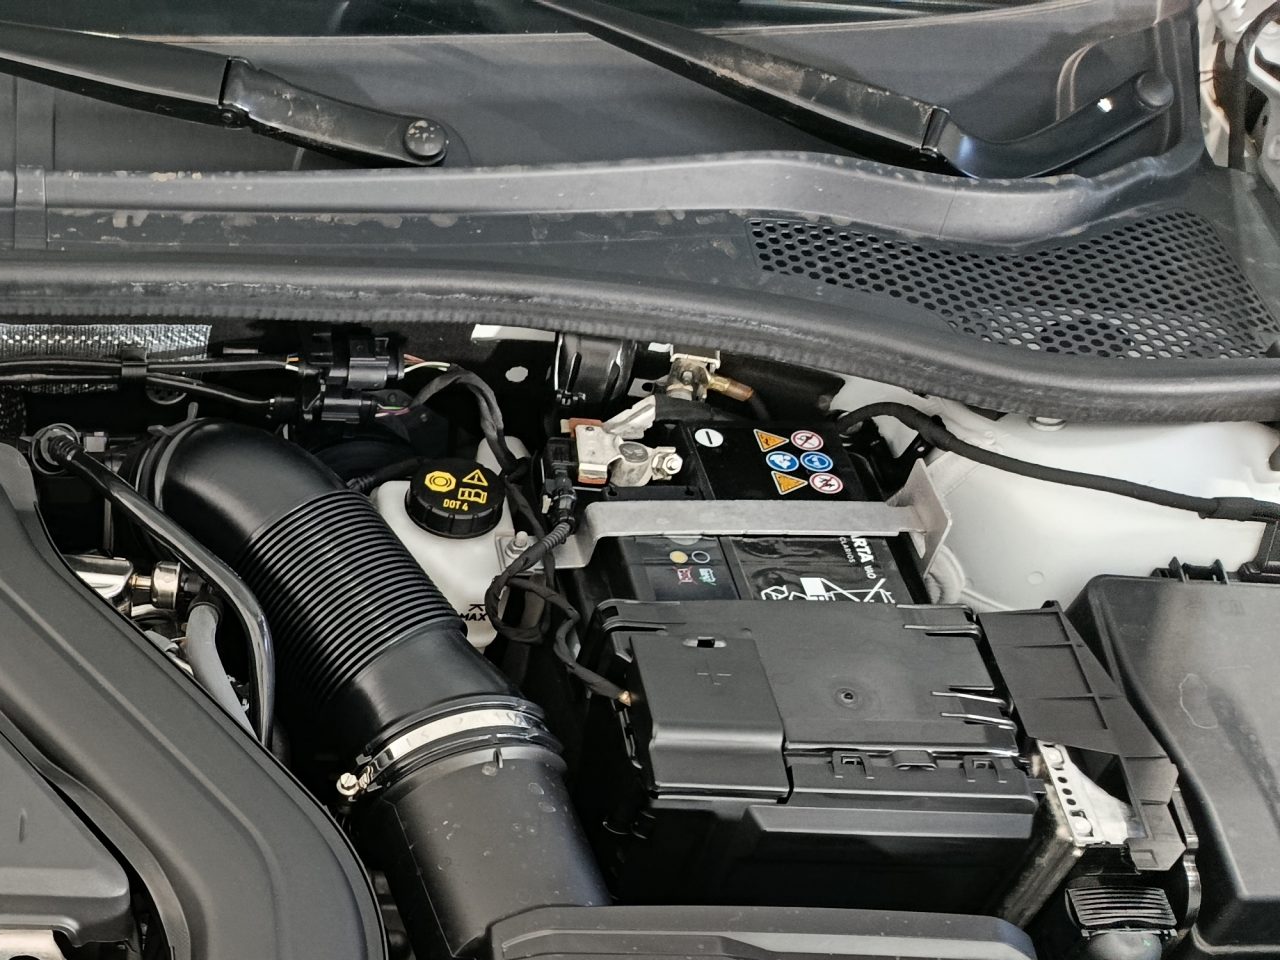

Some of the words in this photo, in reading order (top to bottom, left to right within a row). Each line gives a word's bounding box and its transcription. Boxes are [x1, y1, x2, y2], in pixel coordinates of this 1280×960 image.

[443, 499, 461, 510] DOT
[462, 502, 469, 511] 4
[840, 537, 856, 563] CLARIOS
[460, 613, 488, 621] MAX
